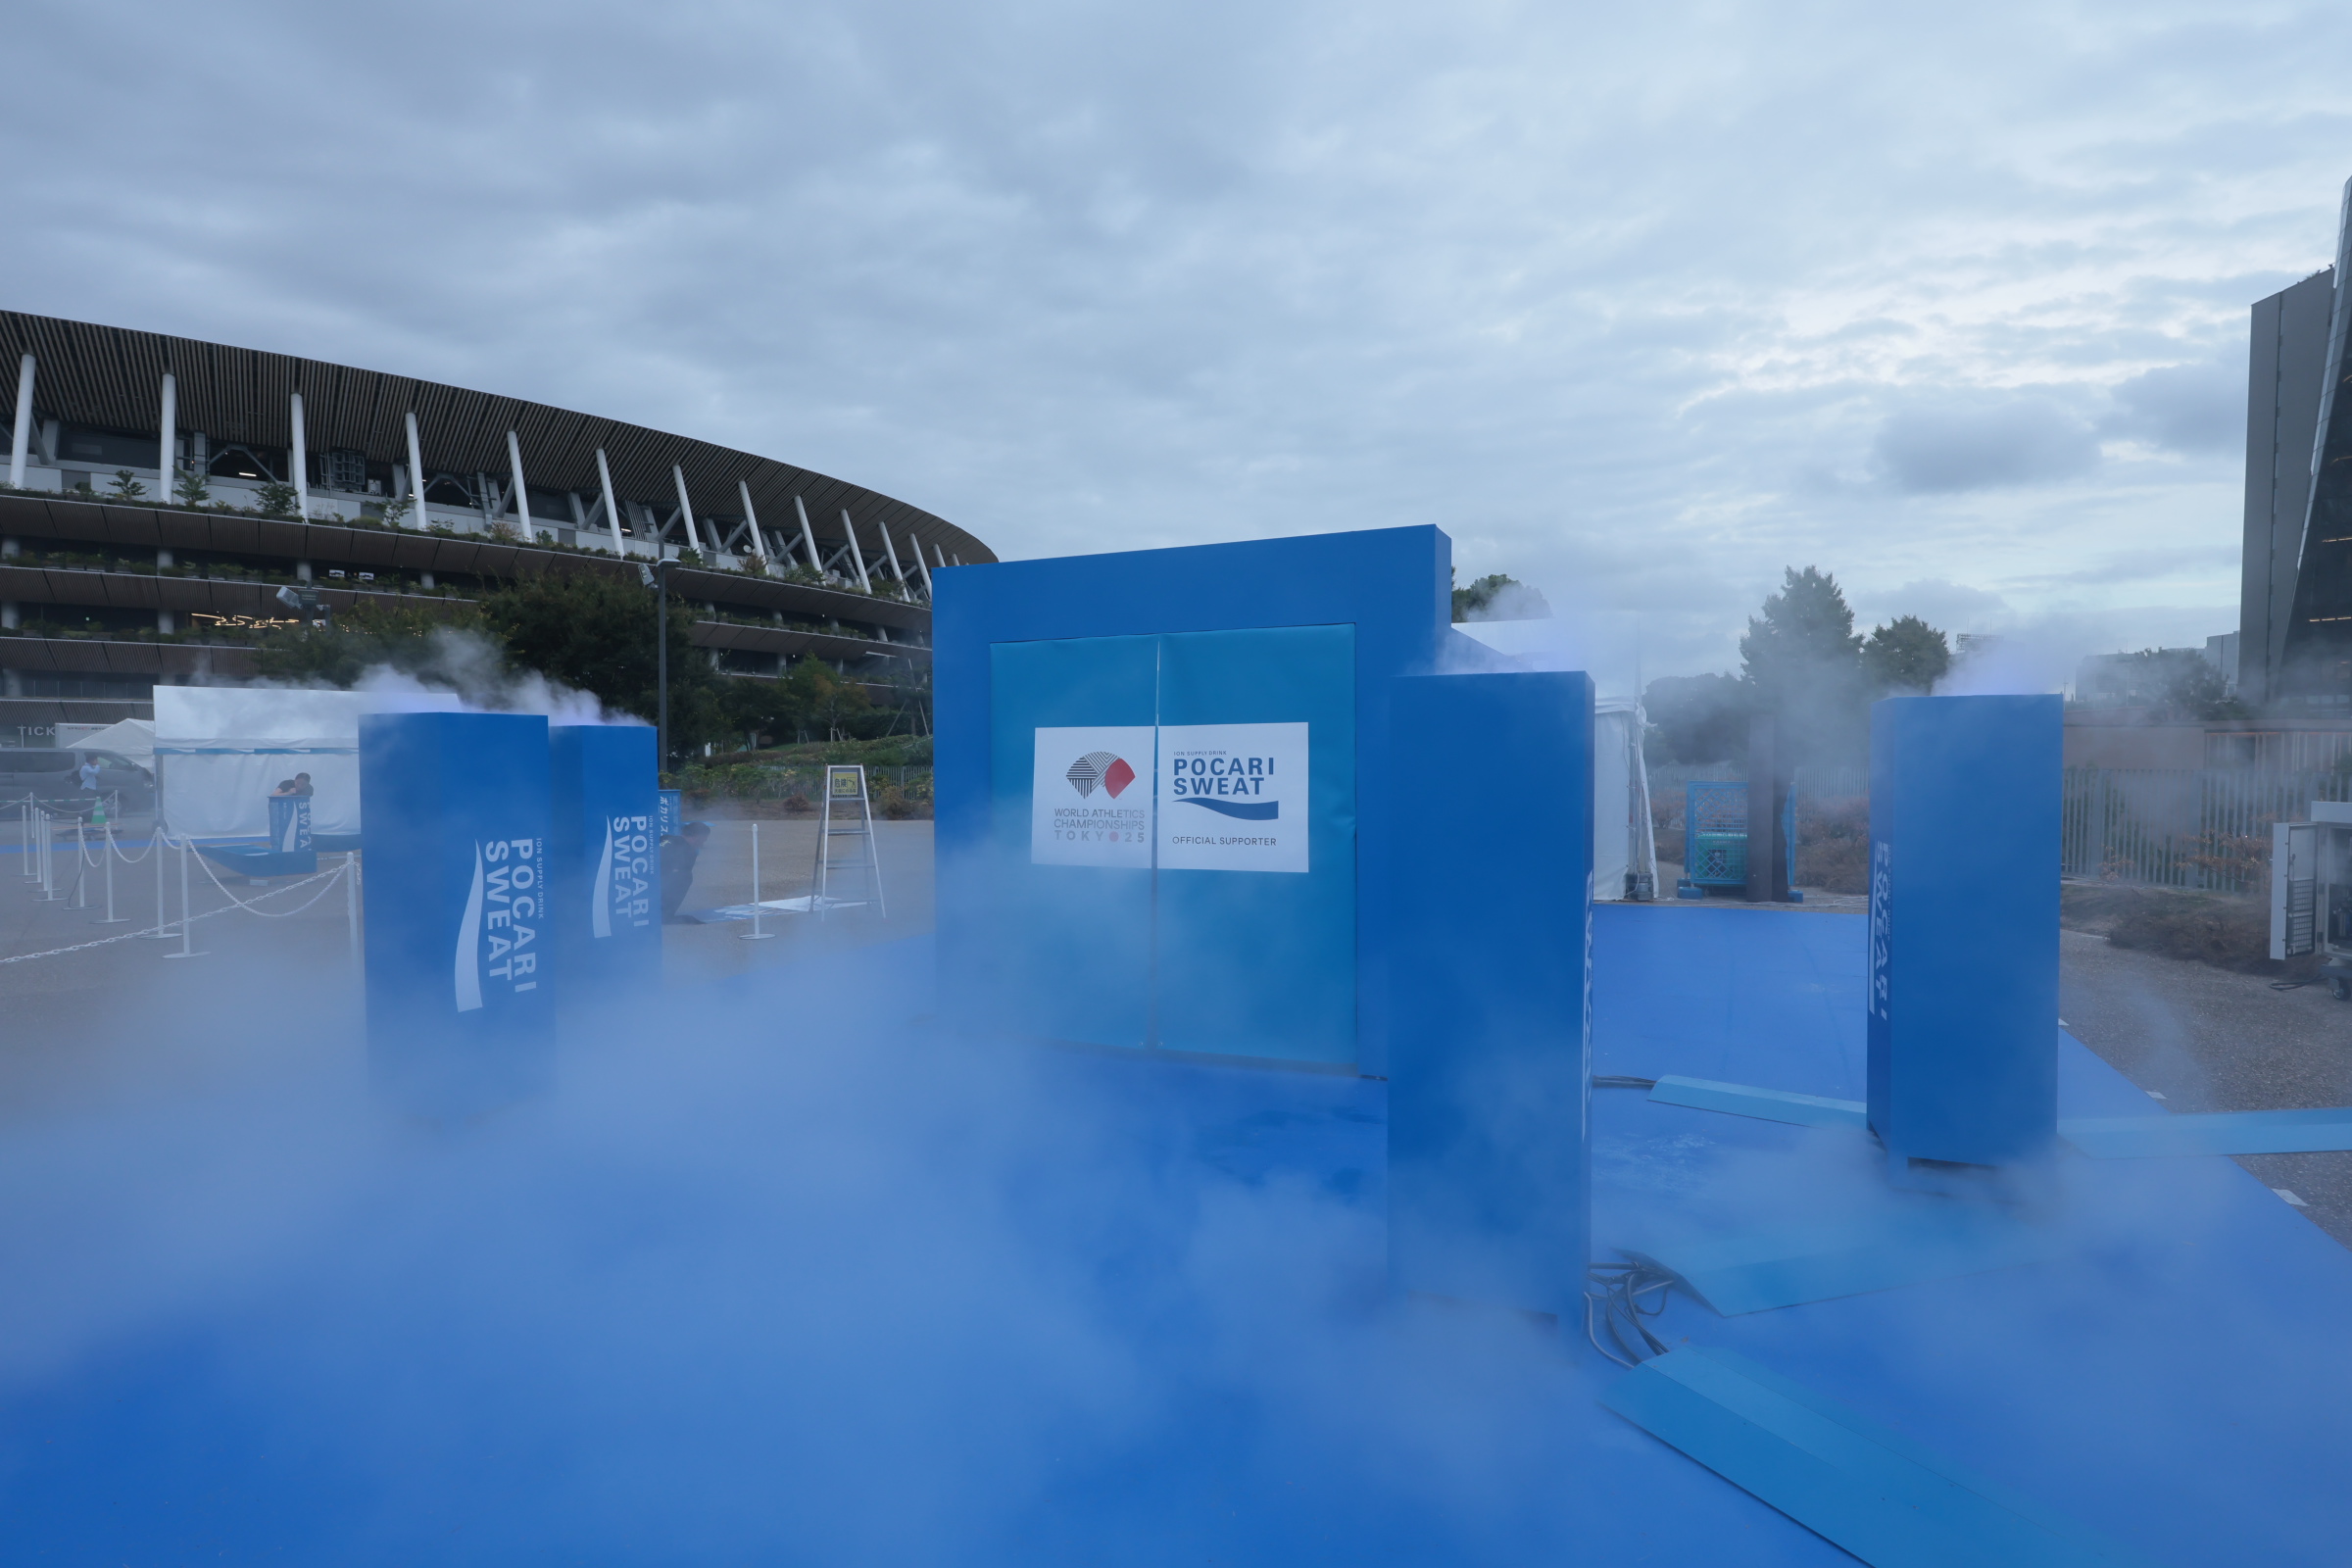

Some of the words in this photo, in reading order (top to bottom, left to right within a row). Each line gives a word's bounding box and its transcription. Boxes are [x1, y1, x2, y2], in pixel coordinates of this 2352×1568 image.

[1173, 757, 1274, 776] POCARI
[1173, 777, 1265, 796] SWEAT
[660, 796, 668, 836] ポカリス
[1054, 808, 1089, 817] WORLD
[1092, 808, 1146, 818] ATHLETICS
[1054, 819, 1146, 830] CHAMPIONSHIPS
[1172, 836, 1217, 845] OFFICIAL
[1219, 837, 1277, 846] SUPPORTER
[612, 816, 632, 918] SWEAT
[631, 816, 649, 927] POCARI
[485, 841, 512, 981] SWEAT
[511, 839, 537, 993] POCARI
